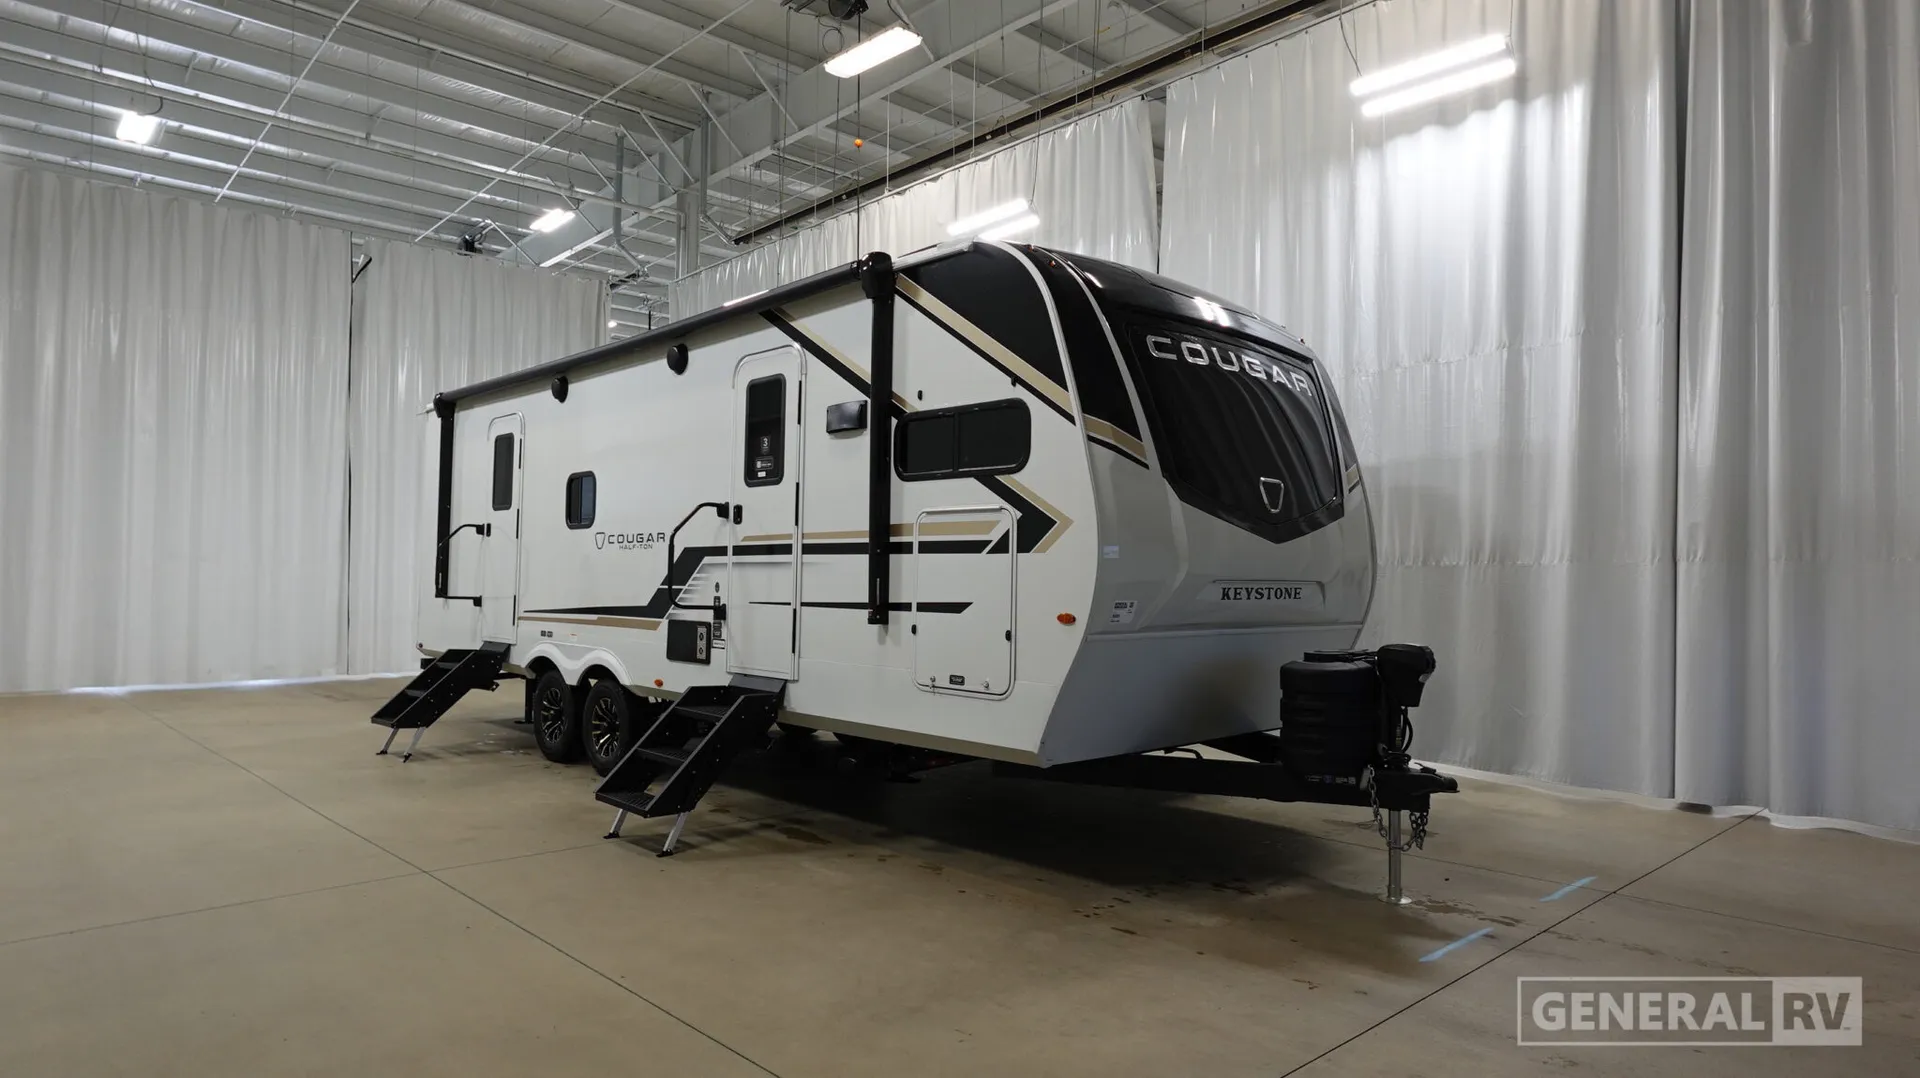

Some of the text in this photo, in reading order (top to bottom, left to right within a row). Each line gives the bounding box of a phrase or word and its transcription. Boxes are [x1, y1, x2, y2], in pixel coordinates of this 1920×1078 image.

[1146, 335, 1313, 397] COUGAR
[607, 532, 666, 545] COUGAR
[618, 543, 653, 551] HALF-TON
[1220, 587, 1303, 601] KEYSTONE
